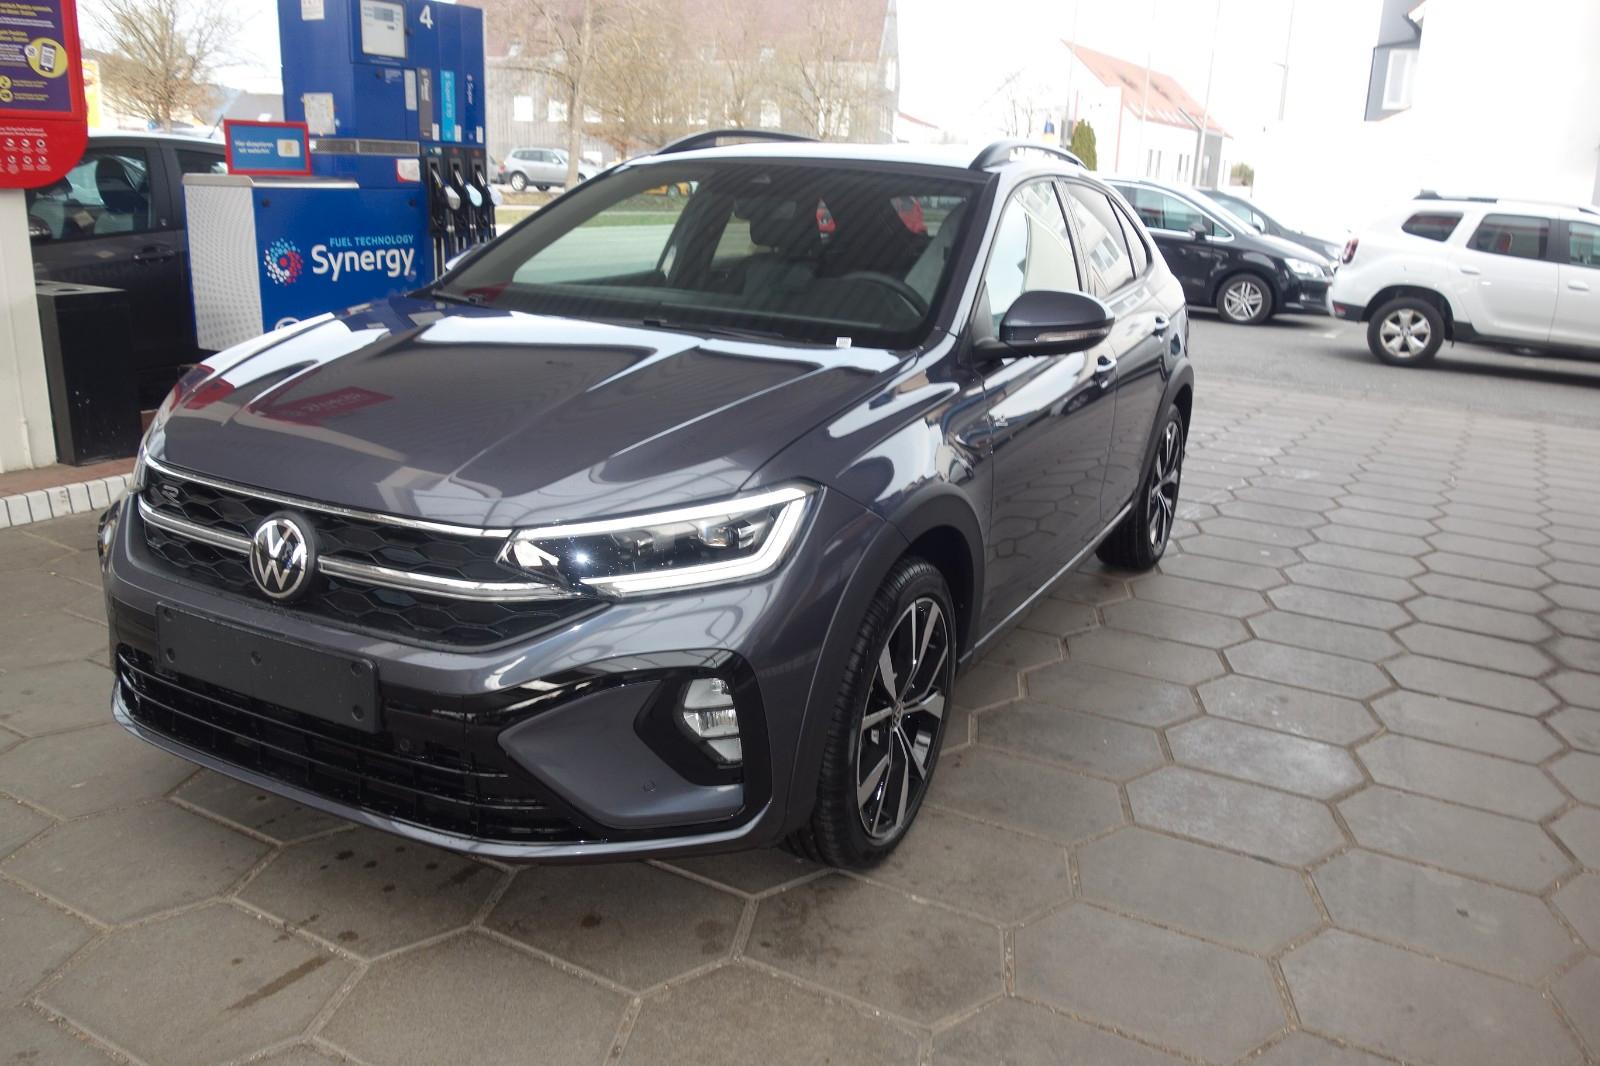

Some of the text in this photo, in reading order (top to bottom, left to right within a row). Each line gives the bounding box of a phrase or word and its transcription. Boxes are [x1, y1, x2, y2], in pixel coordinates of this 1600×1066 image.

[419, 4, 434, 29] 4
[329, 234, 414, 248] FUEL TECHNOLOGY
[311, 244, 415, 282] Synergy
